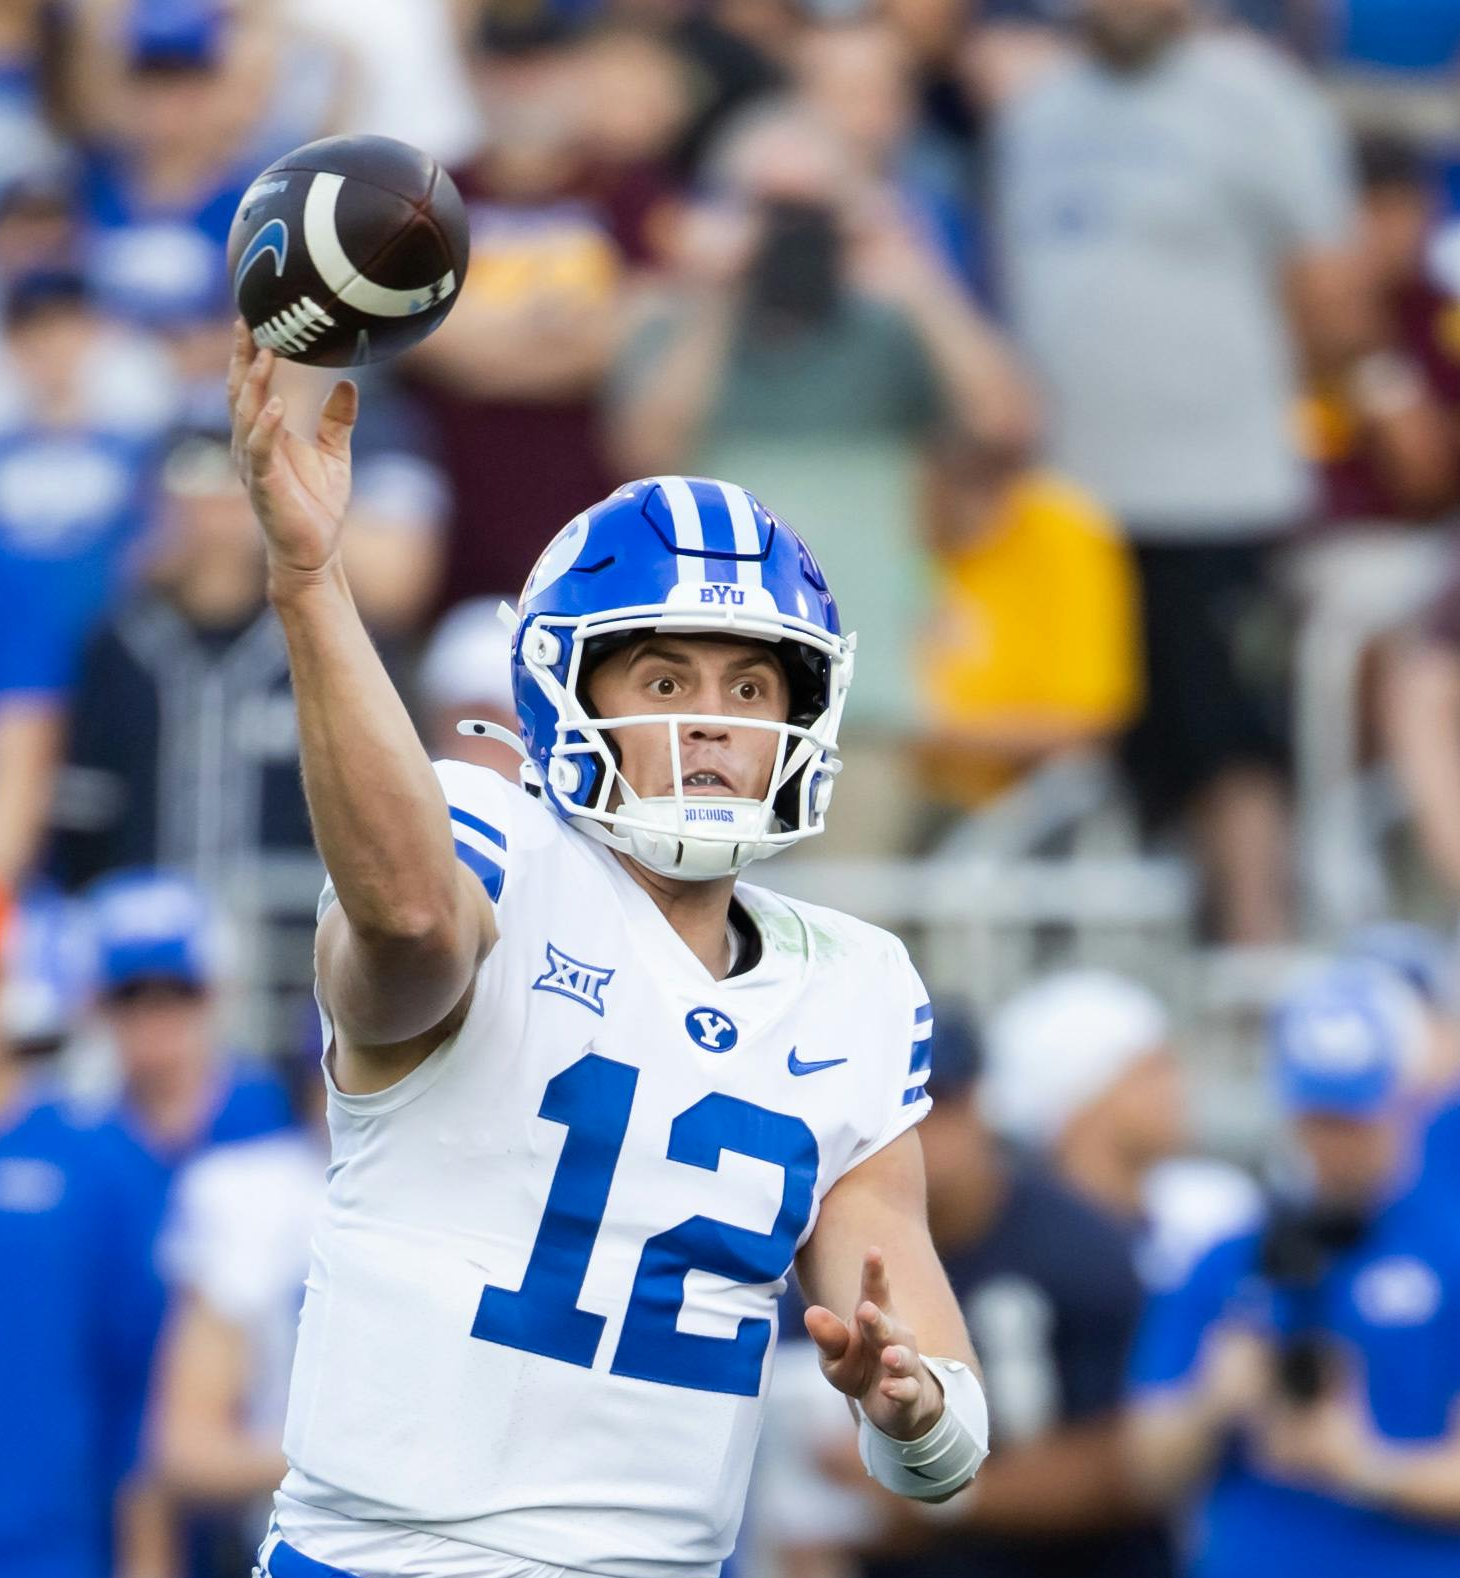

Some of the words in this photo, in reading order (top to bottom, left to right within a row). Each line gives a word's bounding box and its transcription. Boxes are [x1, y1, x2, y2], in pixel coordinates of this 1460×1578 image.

[700, 585, 745, 605] BYU
[698, 808, 735, 823] COUGS
[693, 1012, 732, 1049] Y
[470, 1052, 820, 1397] 12
